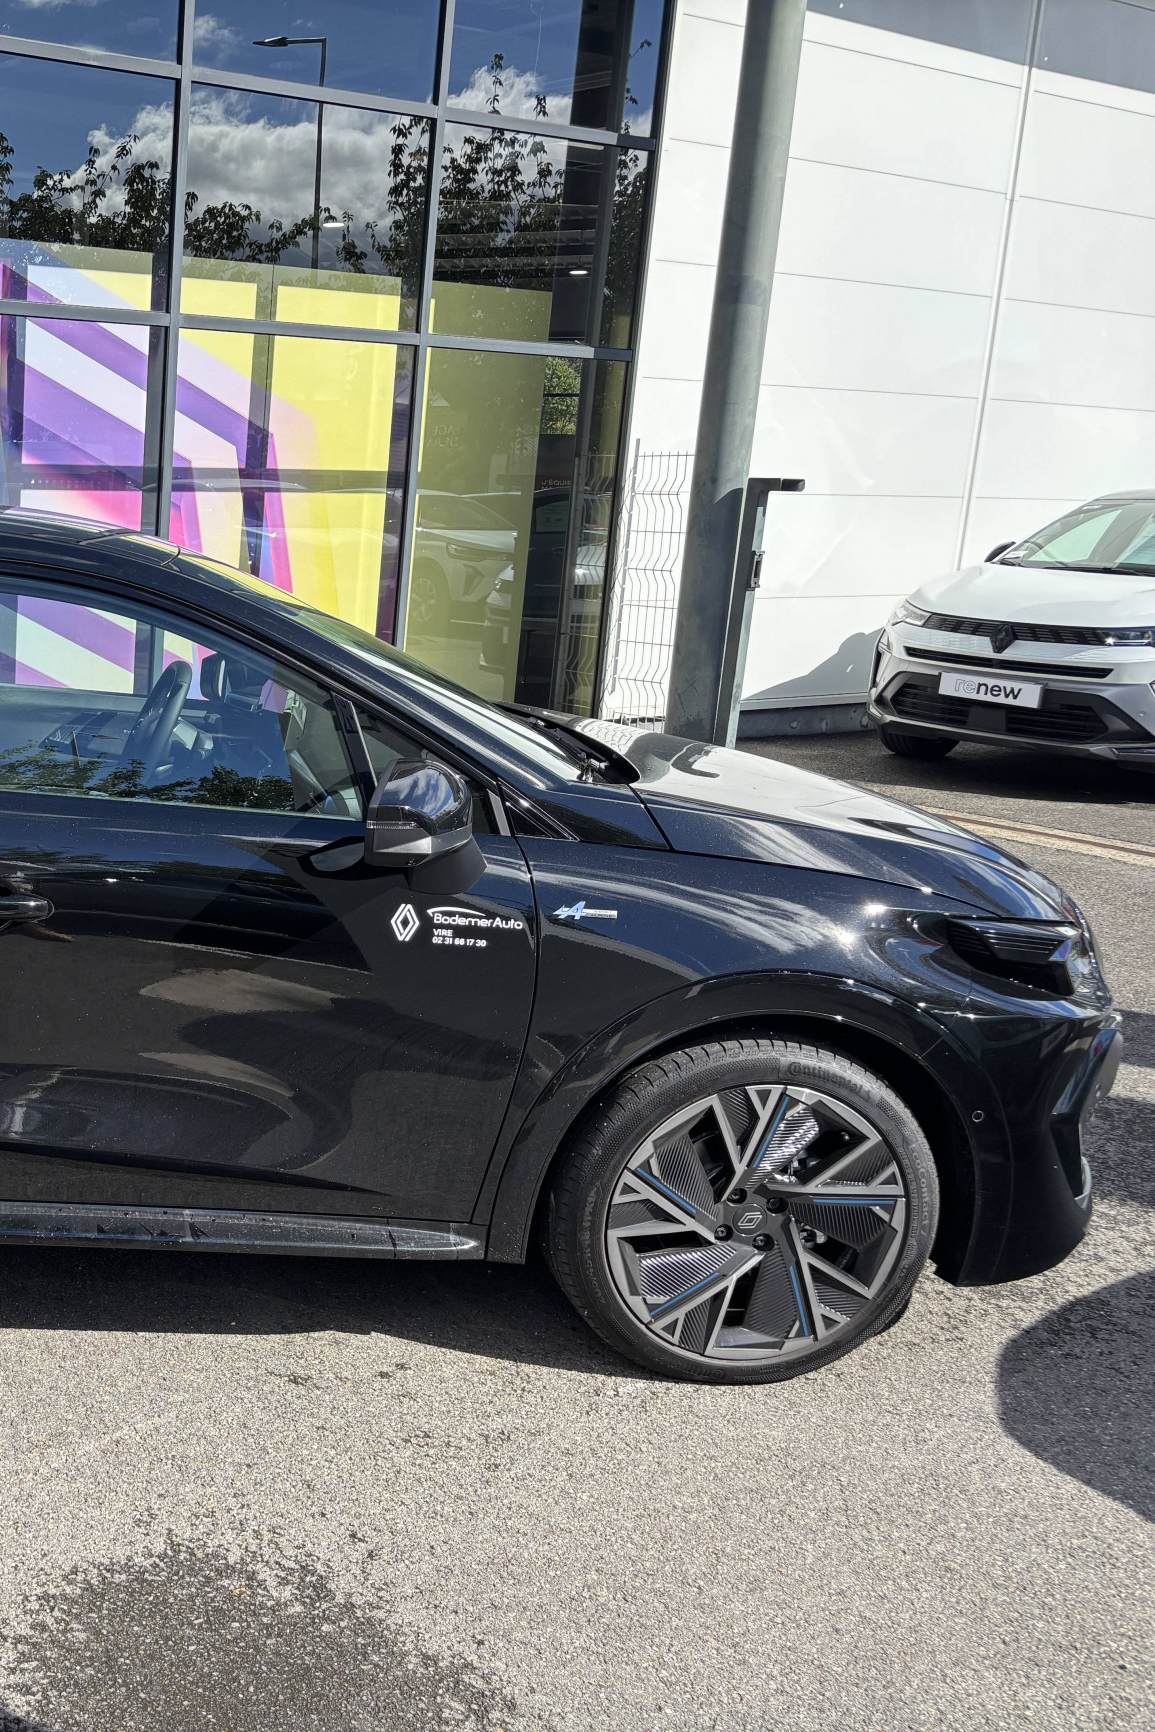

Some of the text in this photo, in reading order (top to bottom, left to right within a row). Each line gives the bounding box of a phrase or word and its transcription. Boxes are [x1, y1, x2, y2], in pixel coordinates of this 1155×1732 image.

[954, 678, 1022, 700] renew
[432, 936, 443, 944] 02
[444, 937, 452, 945] 31
[433, 929, 453, 937] VIRE
[786, 1061, 865, 1099] Continental
